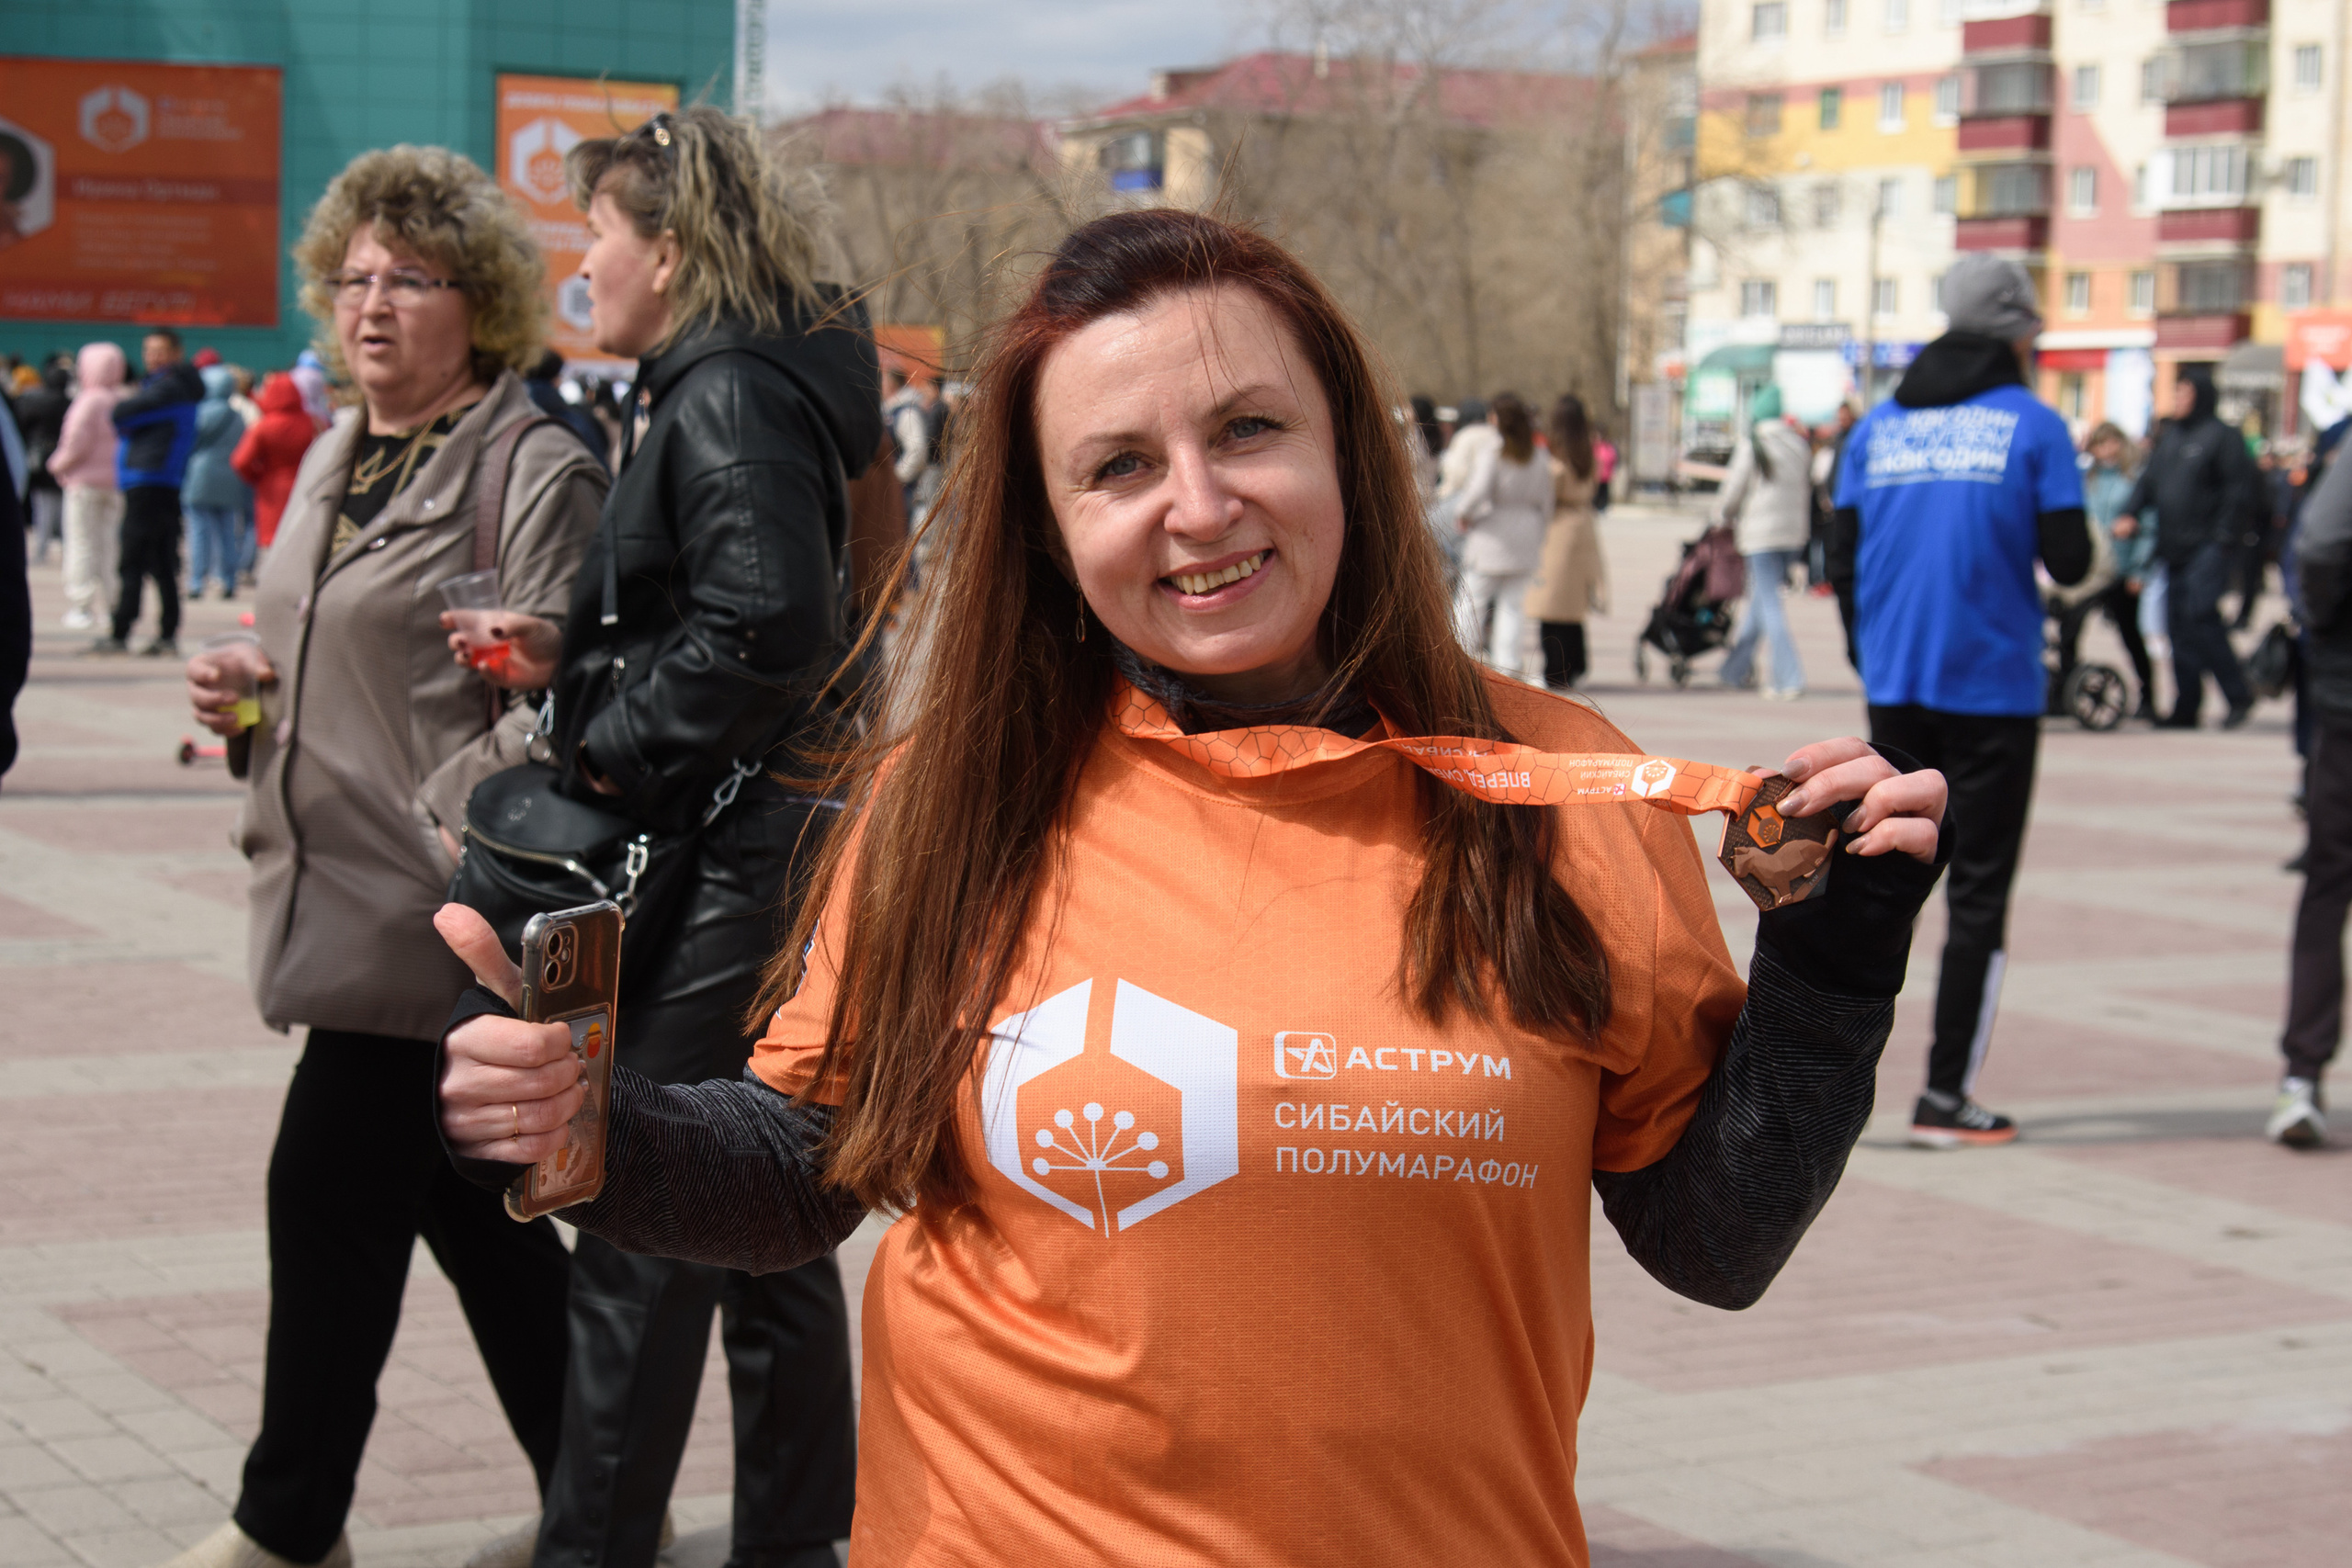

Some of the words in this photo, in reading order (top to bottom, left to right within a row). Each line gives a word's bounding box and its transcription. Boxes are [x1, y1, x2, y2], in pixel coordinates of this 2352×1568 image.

[1569, 759, 1634, 767] ПОЛУМАРАФОН
[1580, 770, 1631, 780] СИБАЙСКИЙ
[1577, 785, 1611, 795] АСТРУМ
[1345, 1046, 1512, 1079] АСТРУМ
[1274, 1100, 1505, 1142] СИБАЙСКИЙ
[1276, 1146, 1539, 1189] ПОЛУМАРАФОН
